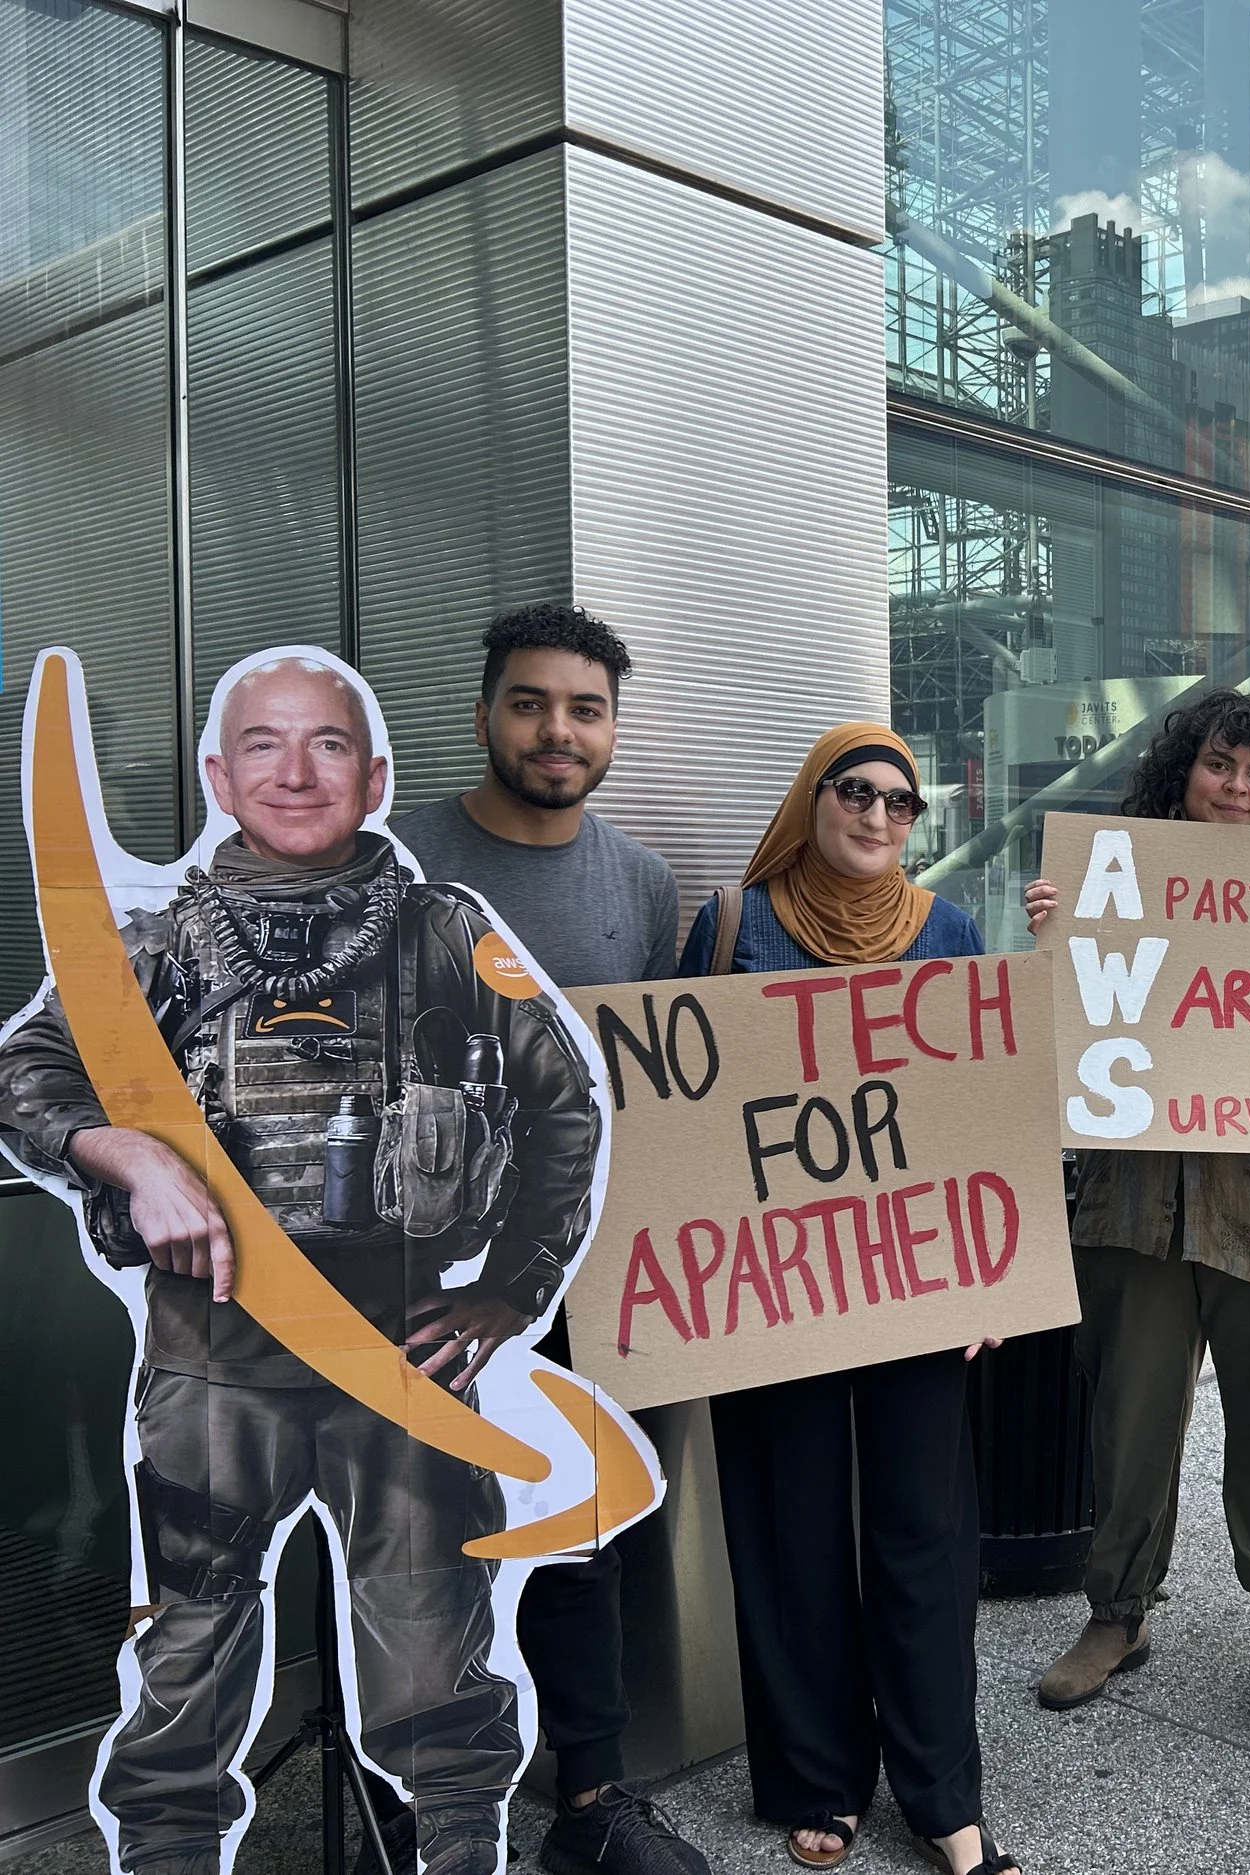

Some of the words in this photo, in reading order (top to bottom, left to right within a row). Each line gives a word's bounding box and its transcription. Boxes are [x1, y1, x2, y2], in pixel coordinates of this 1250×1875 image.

[1081, 701, 1117, 713] JAVITS
[596, 993, 720, 1110] NO
[762, 960, 1018, 1083] TECH
[742, 1080, 908, 1202] FOR
[617, 1171, 1019, 1358] APARTHEID
